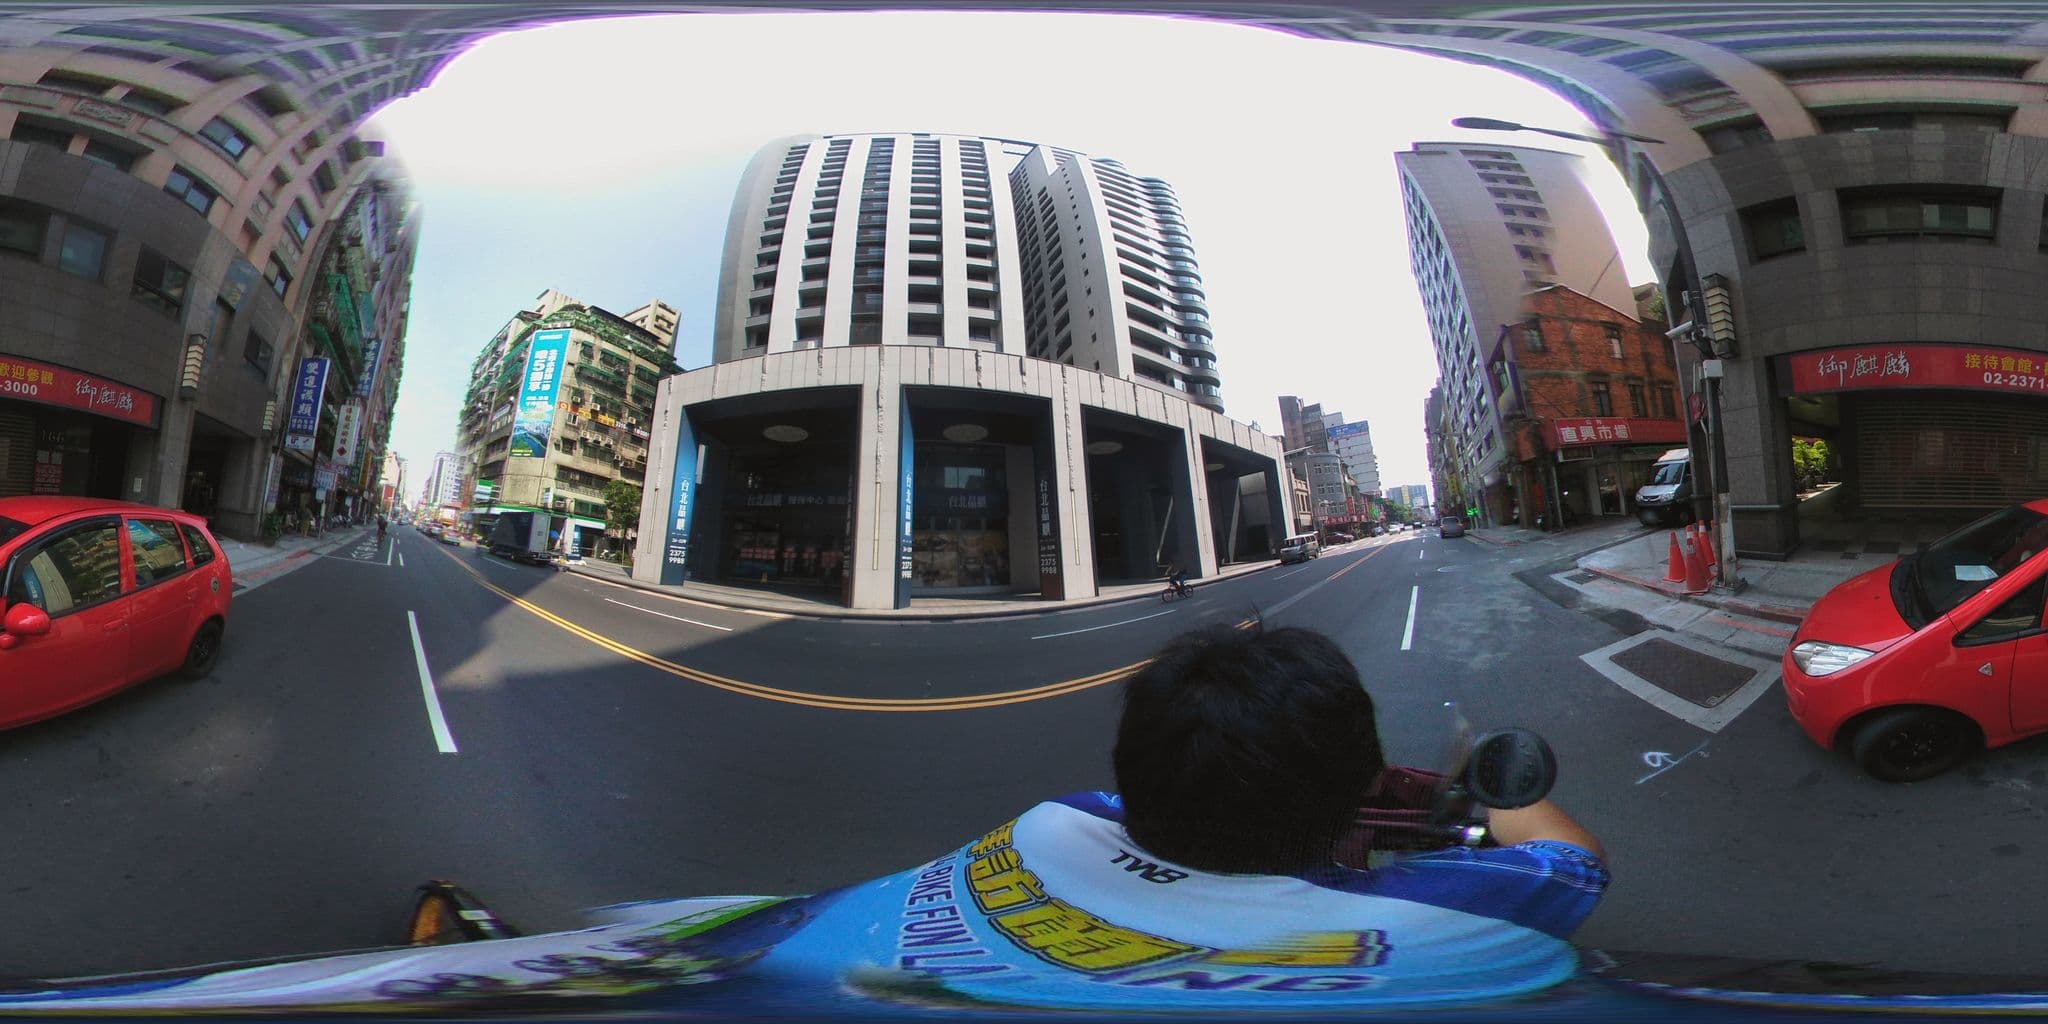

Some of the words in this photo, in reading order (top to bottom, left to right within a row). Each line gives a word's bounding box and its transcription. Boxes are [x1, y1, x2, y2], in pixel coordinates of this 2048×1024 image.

[906, 863, 954, 906] BIKE
[1110, 849, 1189, 884] TWB
[902, 905, 975, 948] FUN
